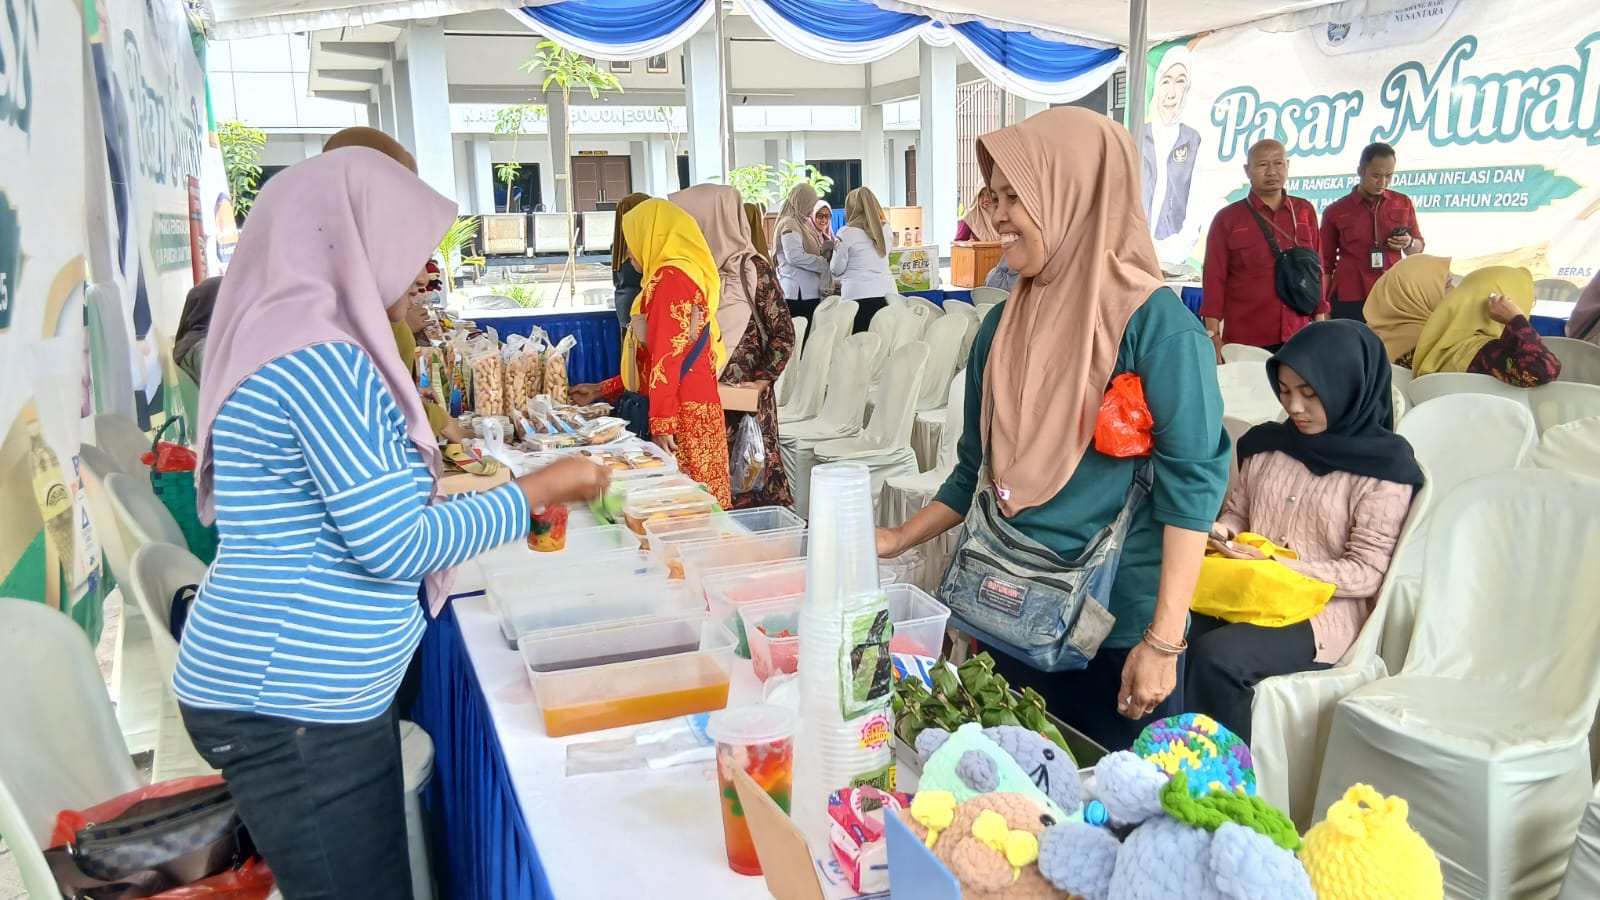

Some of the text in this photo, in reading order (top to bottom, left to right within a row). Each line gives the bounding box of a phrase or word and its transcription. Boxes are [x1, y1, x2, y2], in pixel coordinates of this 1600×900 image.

[1395, 7, 1444, 22] NUSANTARA
[1211, 85, 1364, 161] Pasar
[1302, 177, 1344, 190] RANGKA
[1439, 170, 1491, 185] INFLASI
[1493, 168, 1526, 183] DAN
[1409, 192, 1529, 208] MUR TAHUN 2025
[1557, 267, 1592, 277] BERAS
